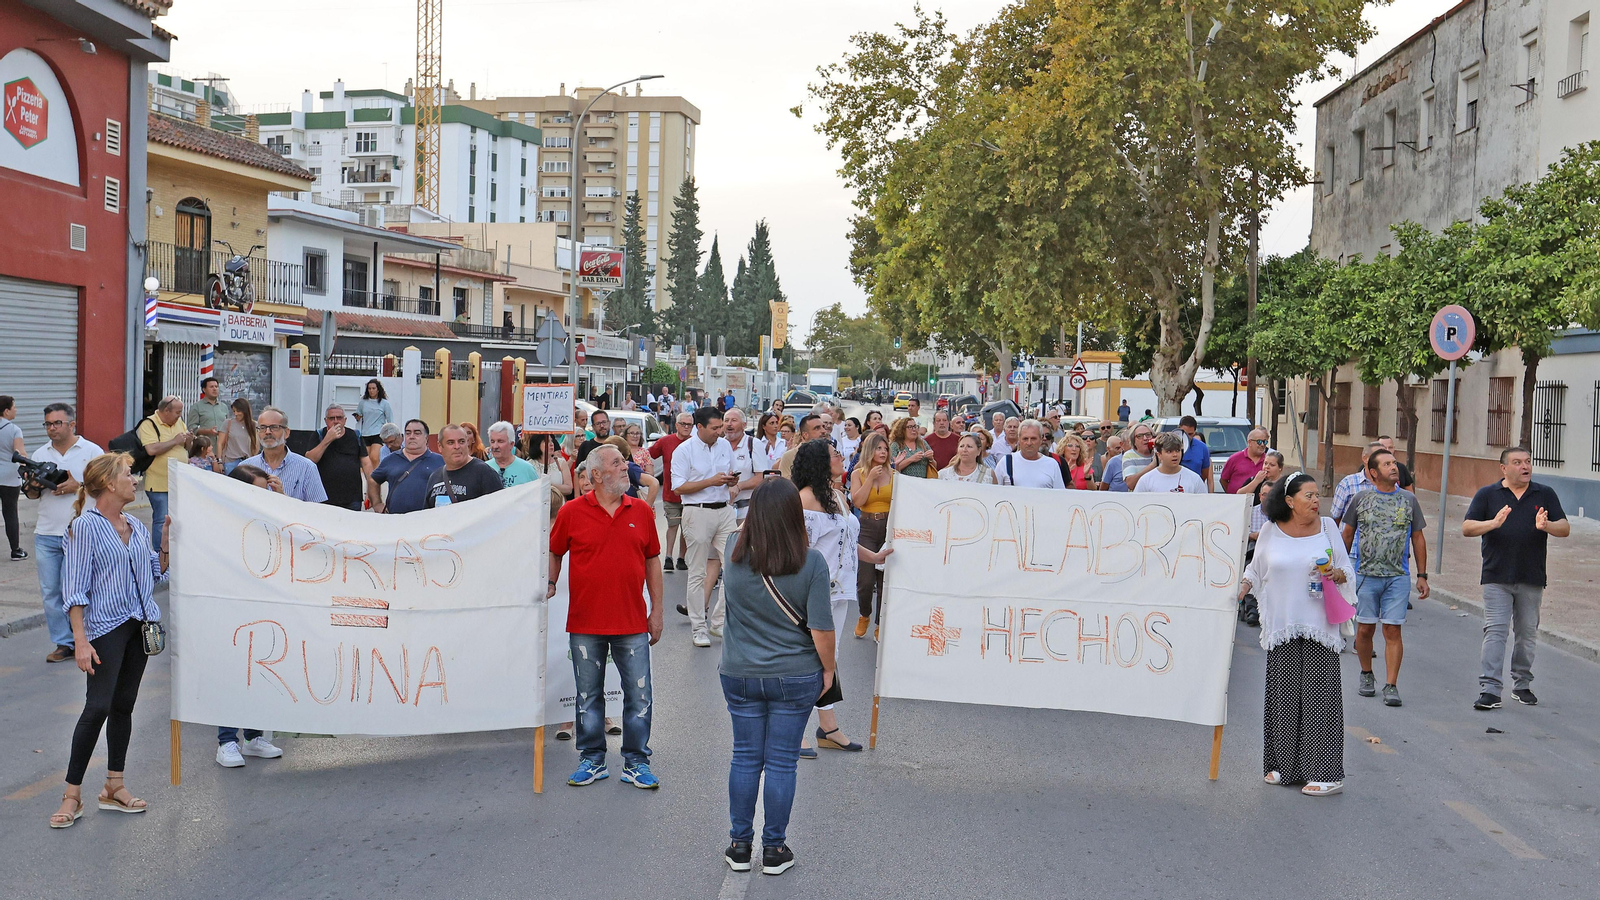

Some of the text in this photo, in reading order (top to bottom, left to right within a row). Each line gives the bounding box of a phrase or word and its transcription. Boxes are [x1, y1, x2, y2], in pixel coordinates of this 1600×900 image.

[16, 86, 43, 109] Pizzería
[20, 106, 39, 125] Peter
[596, 276, 619, 284] ERMITA
[230, 328, 265, 342] DUPLAIN
[1446, 327, 1457, 341] P
[526, 391, 569, 401] MENTIRAS
[528, 414, 569, 426] ENGAÑOS
[431, 484, 467, 498] CALIFRNIA
[934, 497, 1237, 588] PALABRAS
[241, 518, 464, 590] OBRAS
[980, 605, 1175, 675] HECHOS
[232, 618, 449, 707] RUINA
